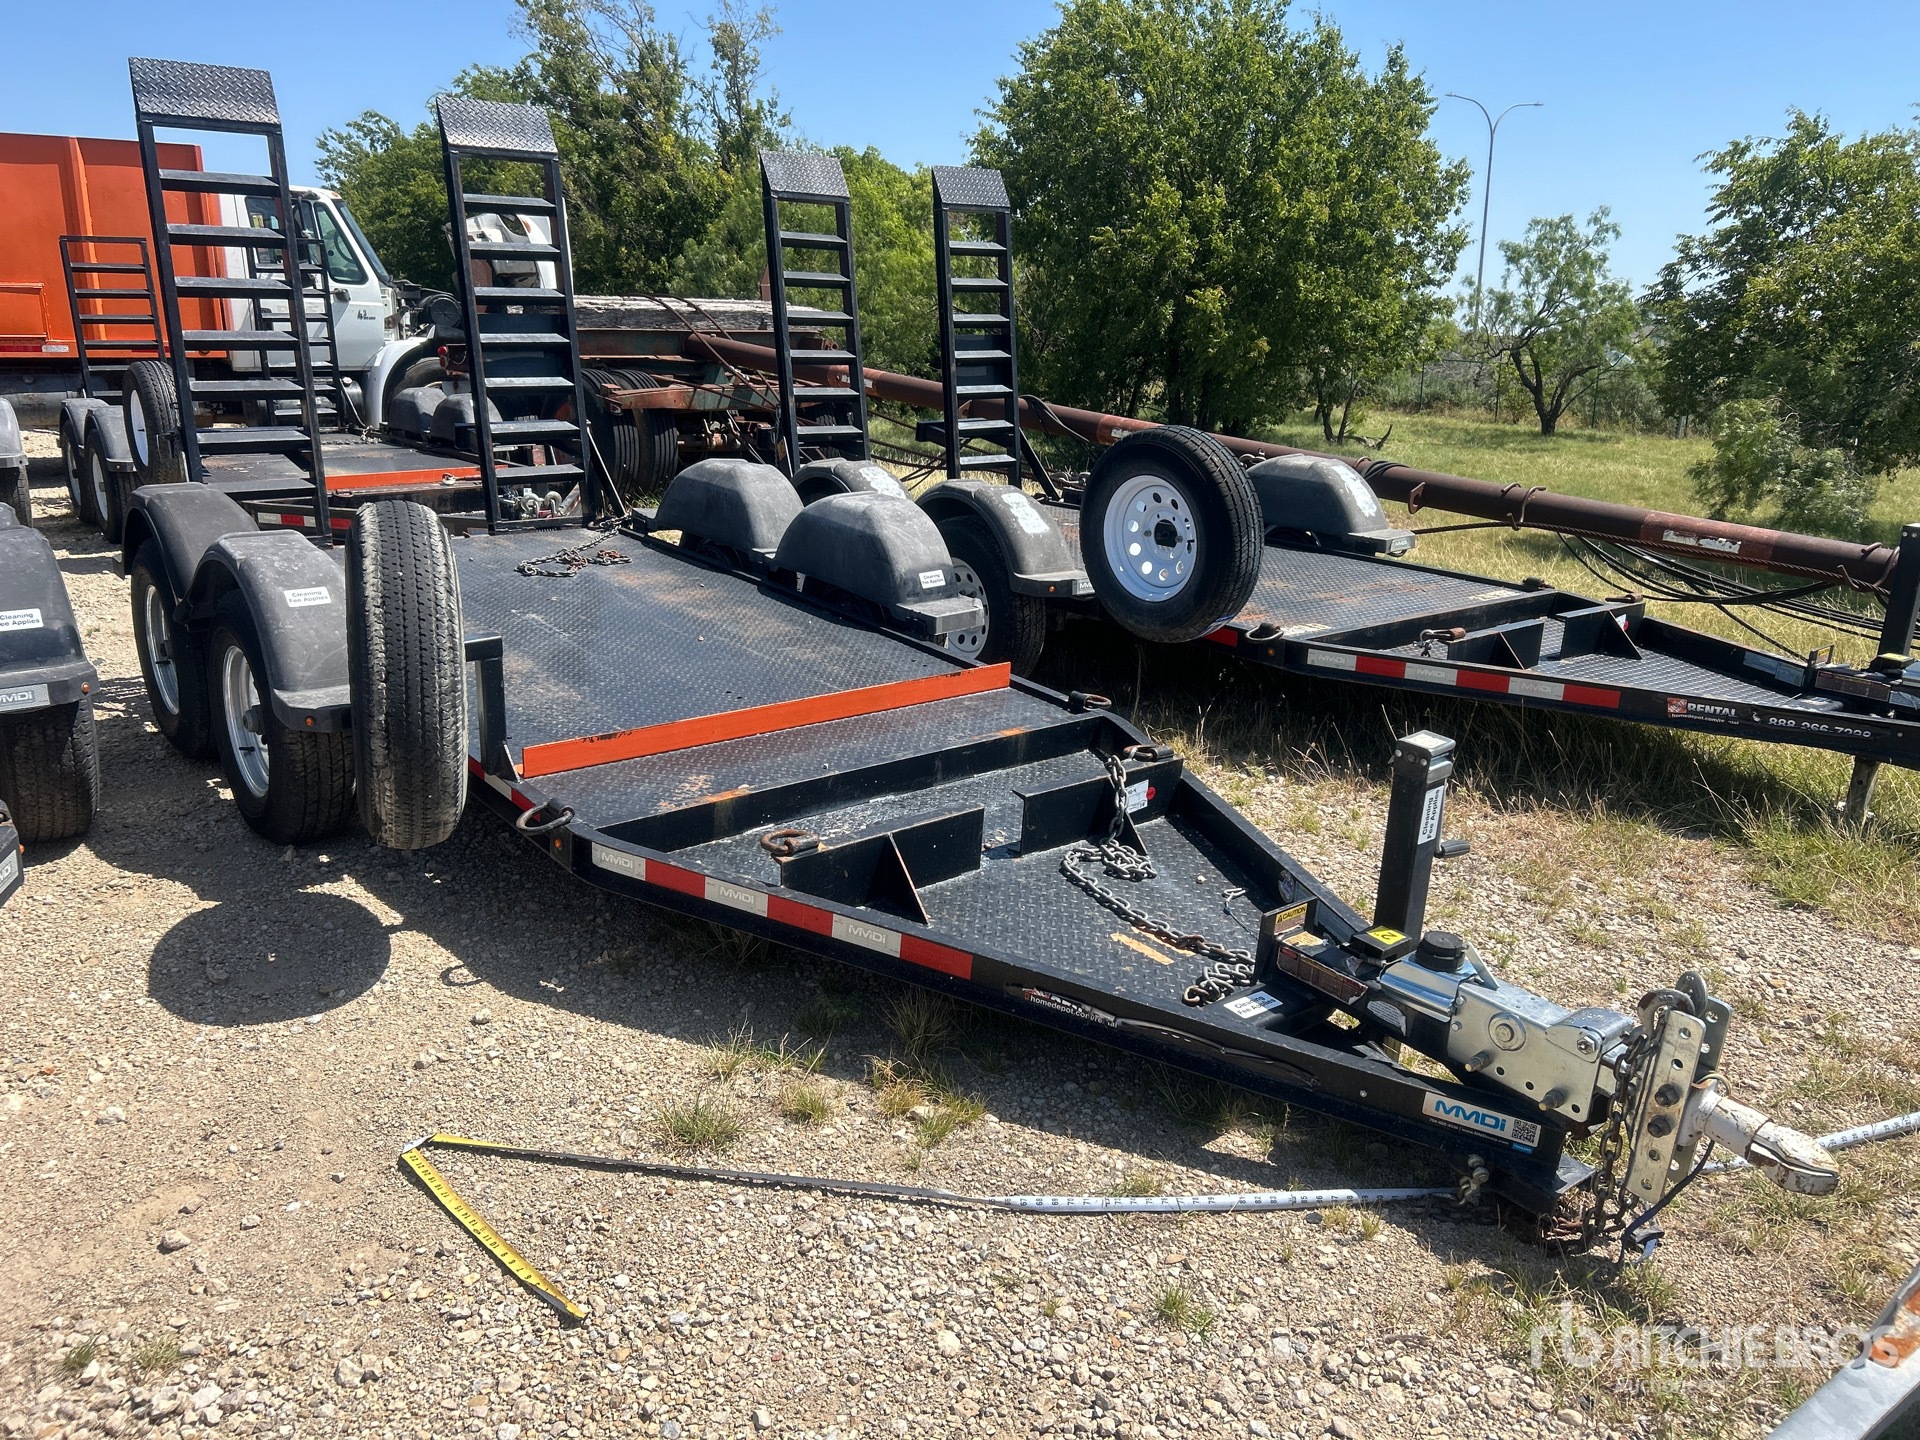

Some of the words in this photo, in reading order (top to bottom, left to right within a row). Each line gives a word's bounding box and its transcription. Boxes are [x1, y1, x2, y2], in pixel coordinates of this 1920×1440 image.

[1688, 702, 1738, 717] RENTAL
[1430, 790, 1439, 820] Applies
[1422, 798, 1433, 835] Cleaning
[1283, 907, 1305, 920] CAUTION
